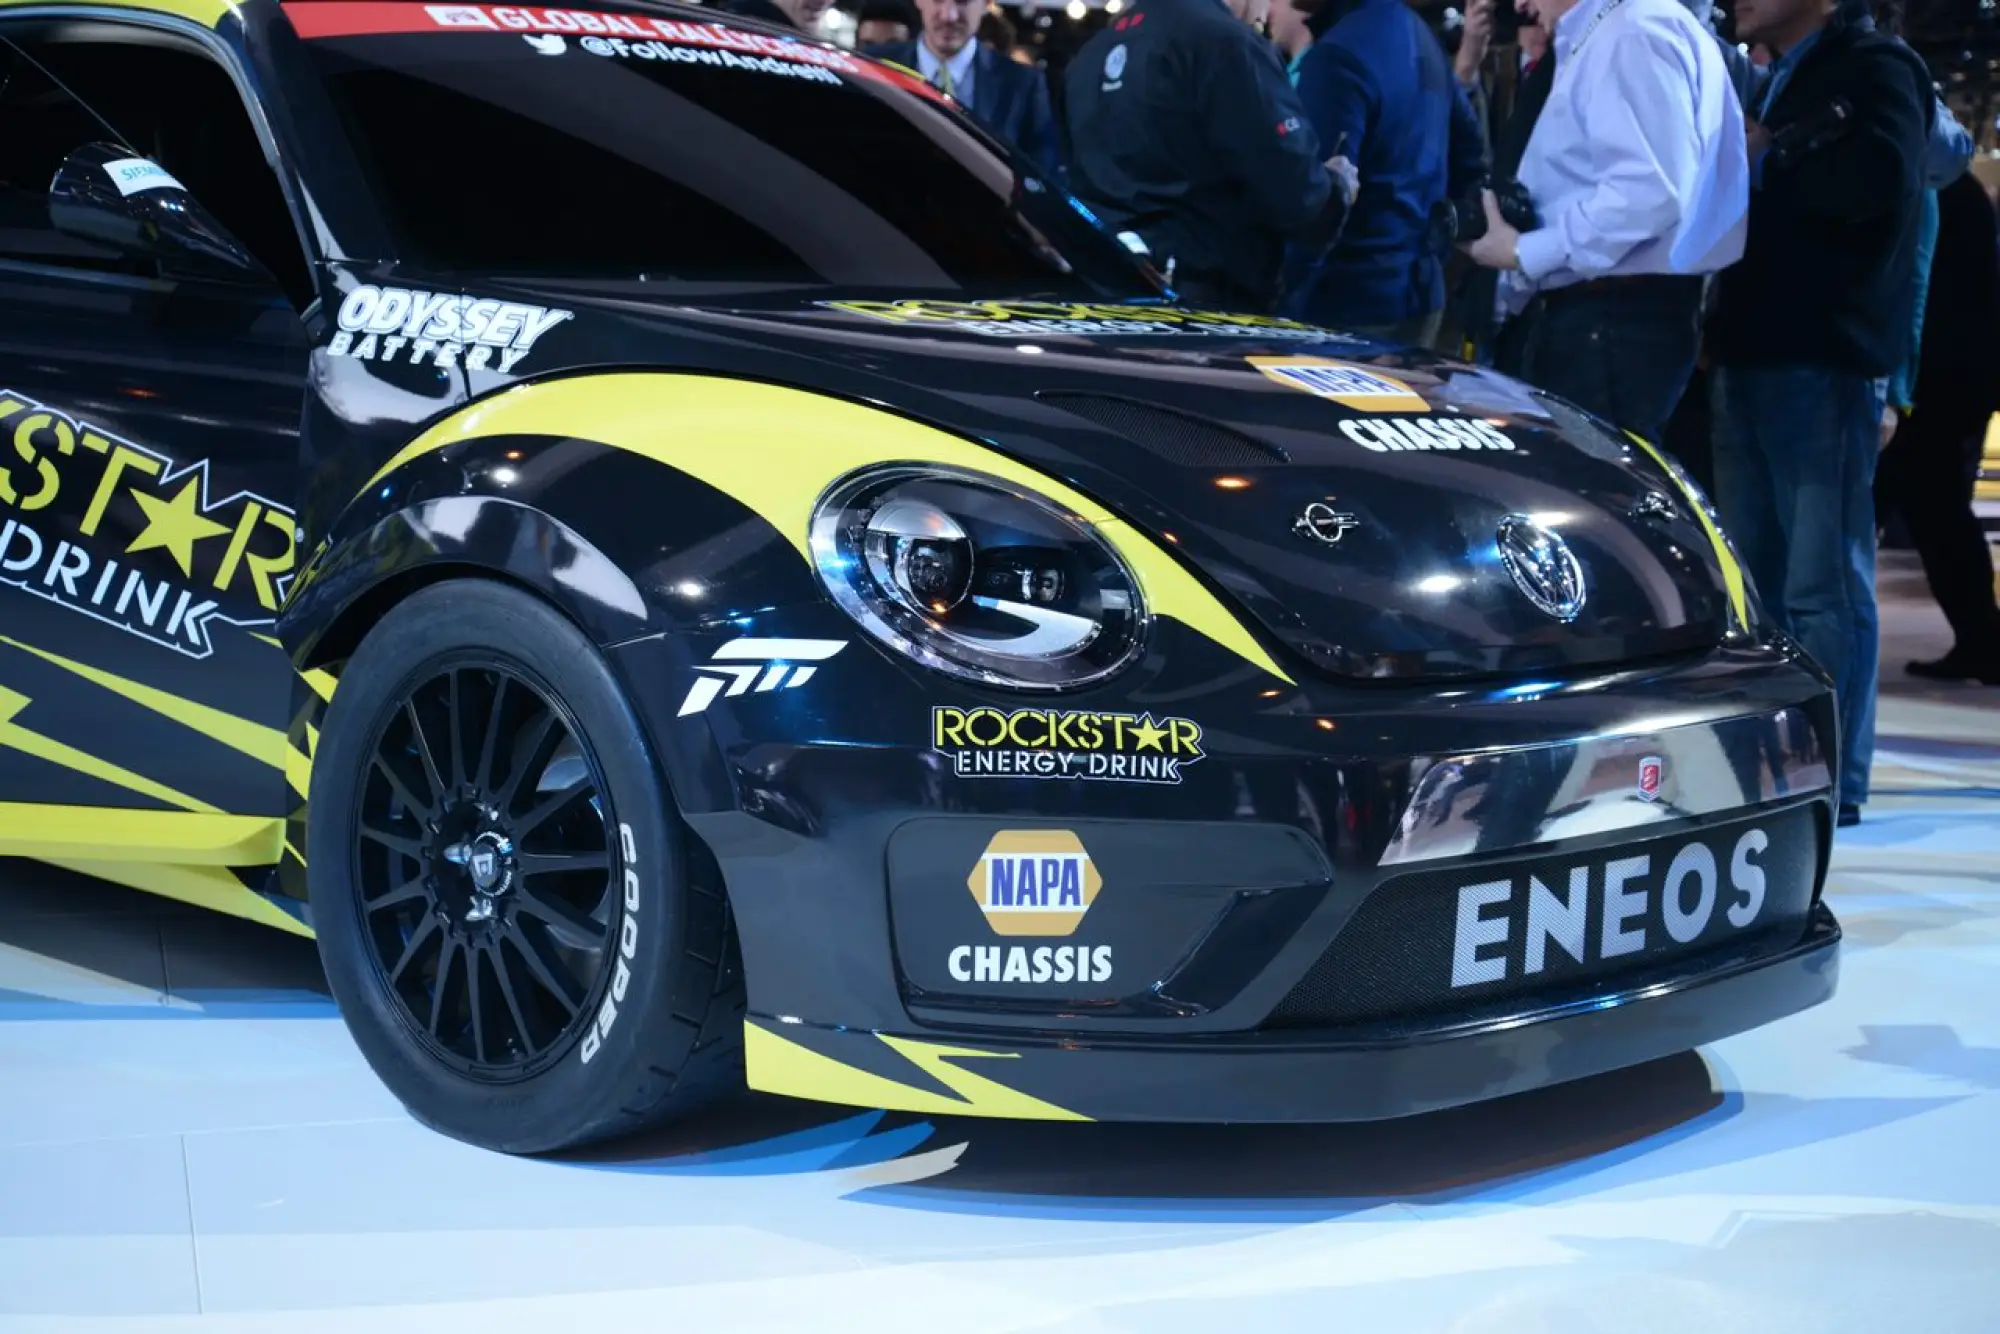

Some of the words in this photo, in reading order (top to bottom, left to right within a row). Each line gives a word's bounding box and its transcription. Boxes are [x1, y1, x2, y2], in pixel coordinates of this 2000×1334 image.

[491, 6, 658, 38] GLOBAL
[337, 284, 572, 349] ODYSSEY
[326, 330, 530, 374] BATTERY
[1337, 417, 1517, 453] CHASSIS
[0, 518, 220, 646] DRINK
[957, 750, 1075, 774] ENERGY
[1088, 753, 1180, 780] DRINK
[990, 858, 1082, 907] NAPA
[1450, 828, 1769, 989] ENEOS
[947, 944, 1114, 983] CHASSIS
